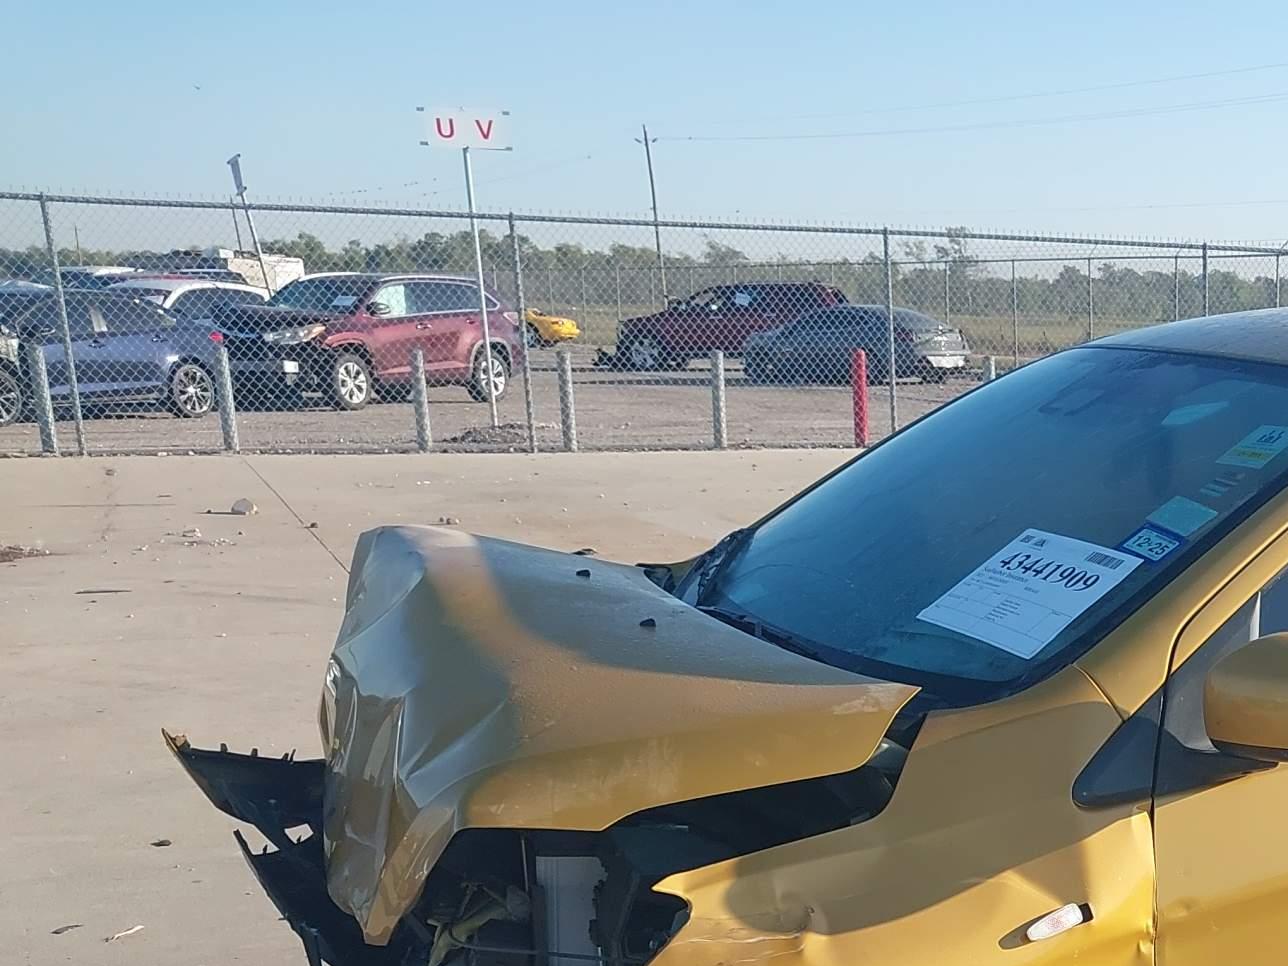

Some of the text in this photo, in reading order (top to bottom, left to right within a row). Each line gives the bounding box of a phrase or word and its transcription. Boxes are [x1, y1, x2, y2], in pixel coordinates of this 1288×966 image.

[435, 117, 493, 140] U V
[1000, 551, 1100, 592] 43441909
